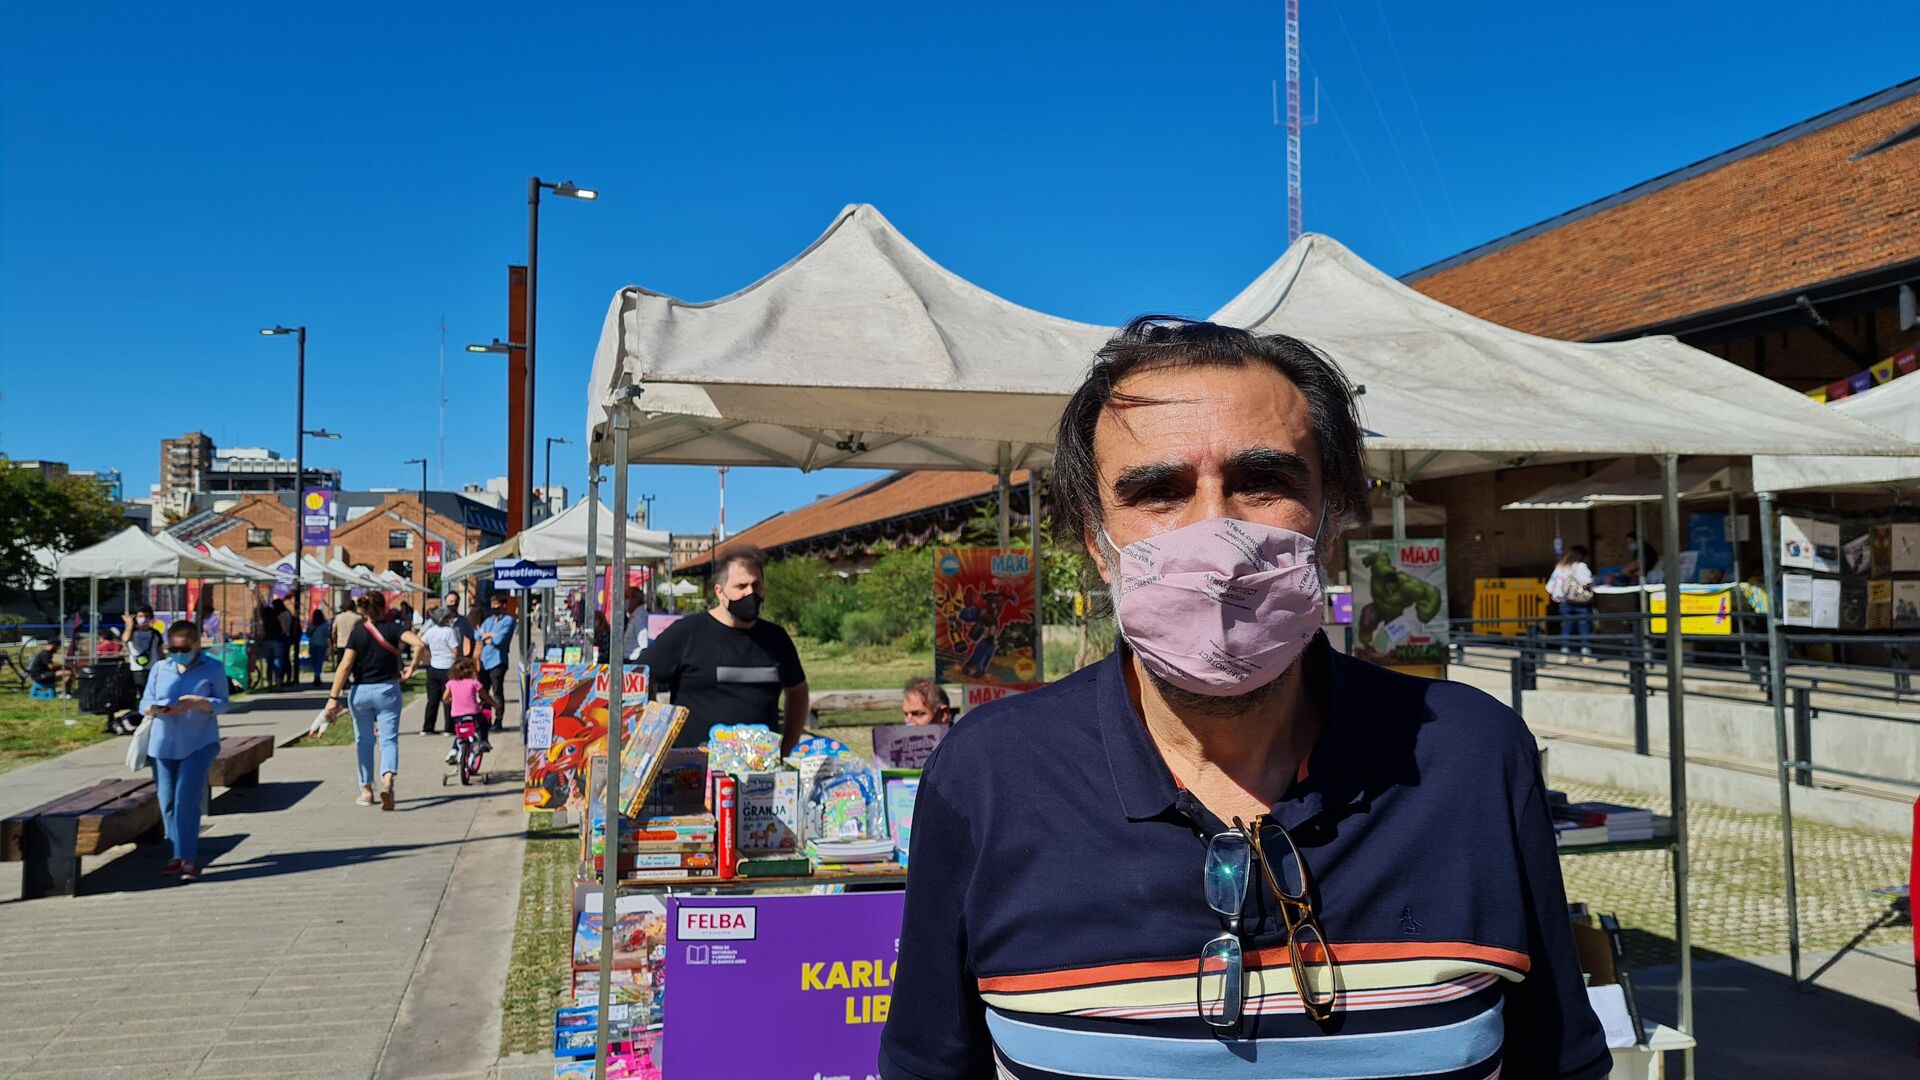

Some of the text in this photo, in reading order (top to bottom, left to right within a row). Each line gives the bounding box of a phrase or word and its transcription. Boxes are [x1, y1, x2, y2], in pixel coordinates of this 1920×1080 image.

[1401, 545, 1440, 563] MAXI
[992, 555, 1029, 572] MAXI
[596, 673, 645, 693] MXI
[743, 805, 787, 817] GRANJA
[687, 914, 746, 929] FELBA
